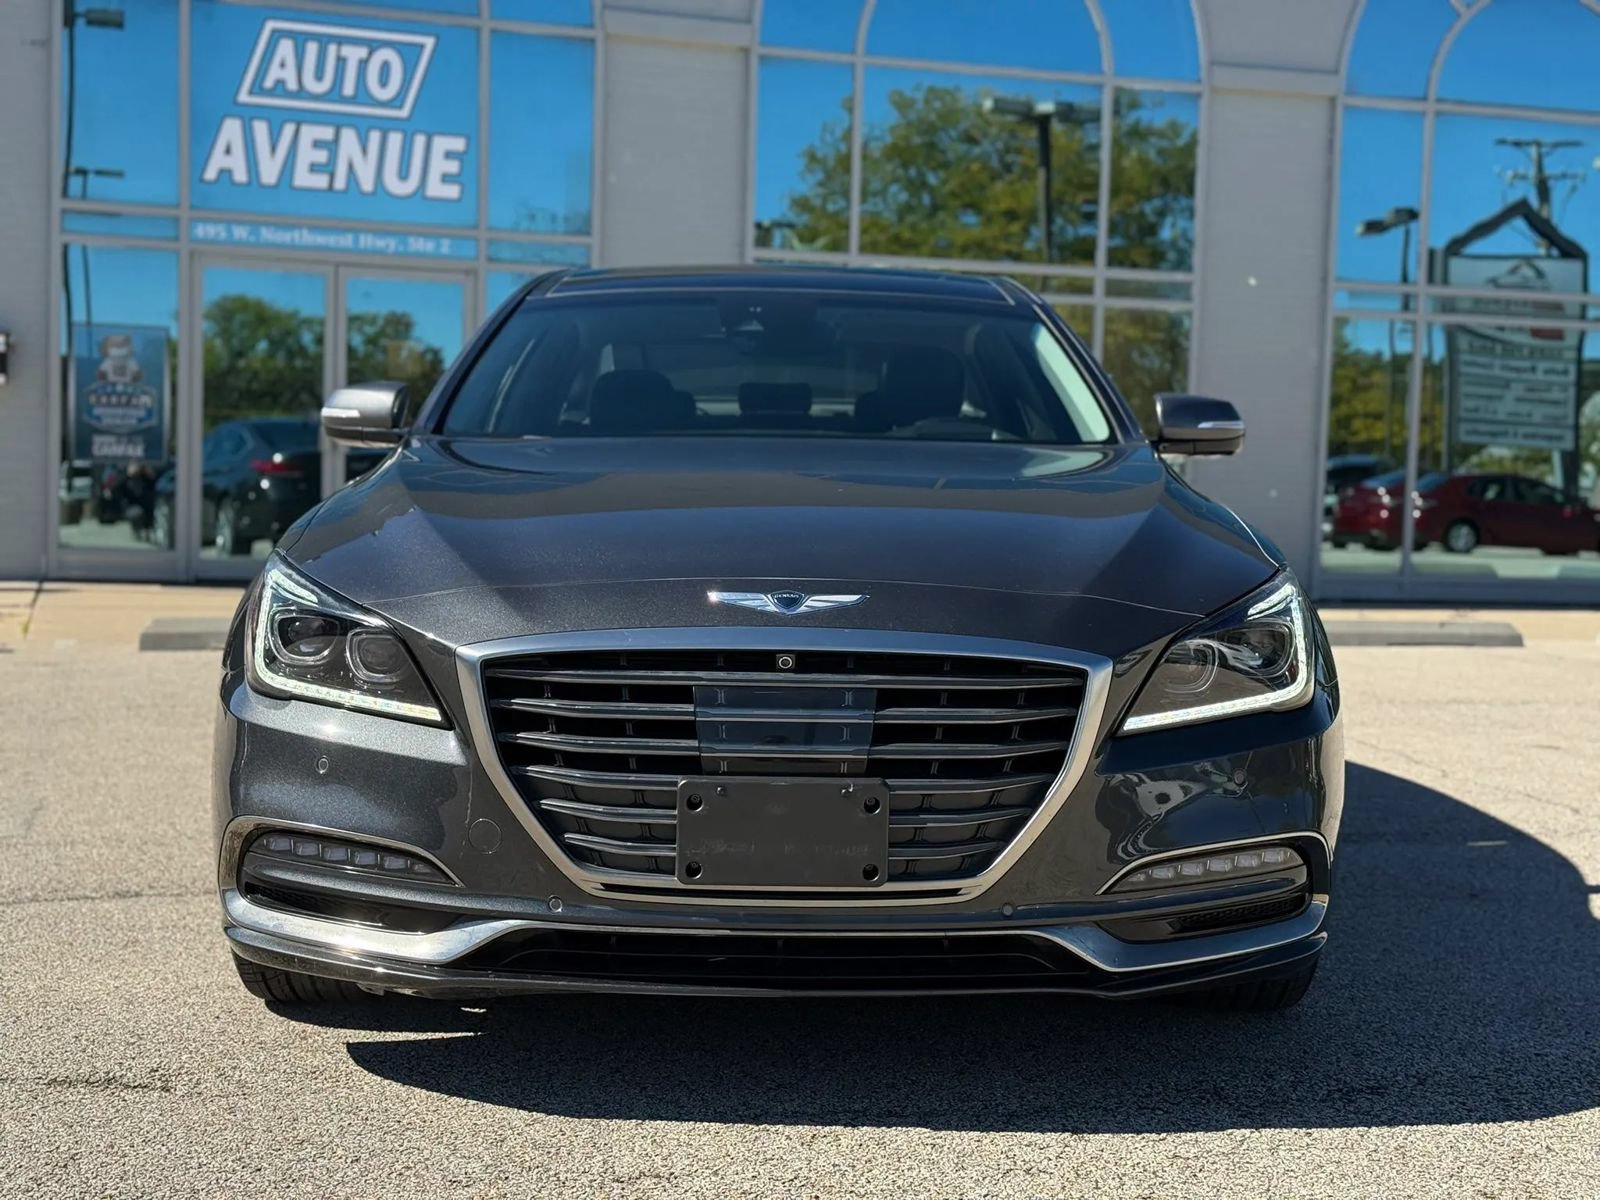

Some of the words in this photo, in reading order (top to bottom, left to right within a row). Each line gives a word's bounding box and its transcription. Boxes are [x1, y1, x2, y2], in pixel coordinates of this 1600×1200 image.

[261, 36, 404, 102] AUTO
[201, 115, 467, 201] AVENUE
[194, 223, 228, 241] 495
[231, 224, 256, 242] W.
[259, 225, 353, 248] Northwest
